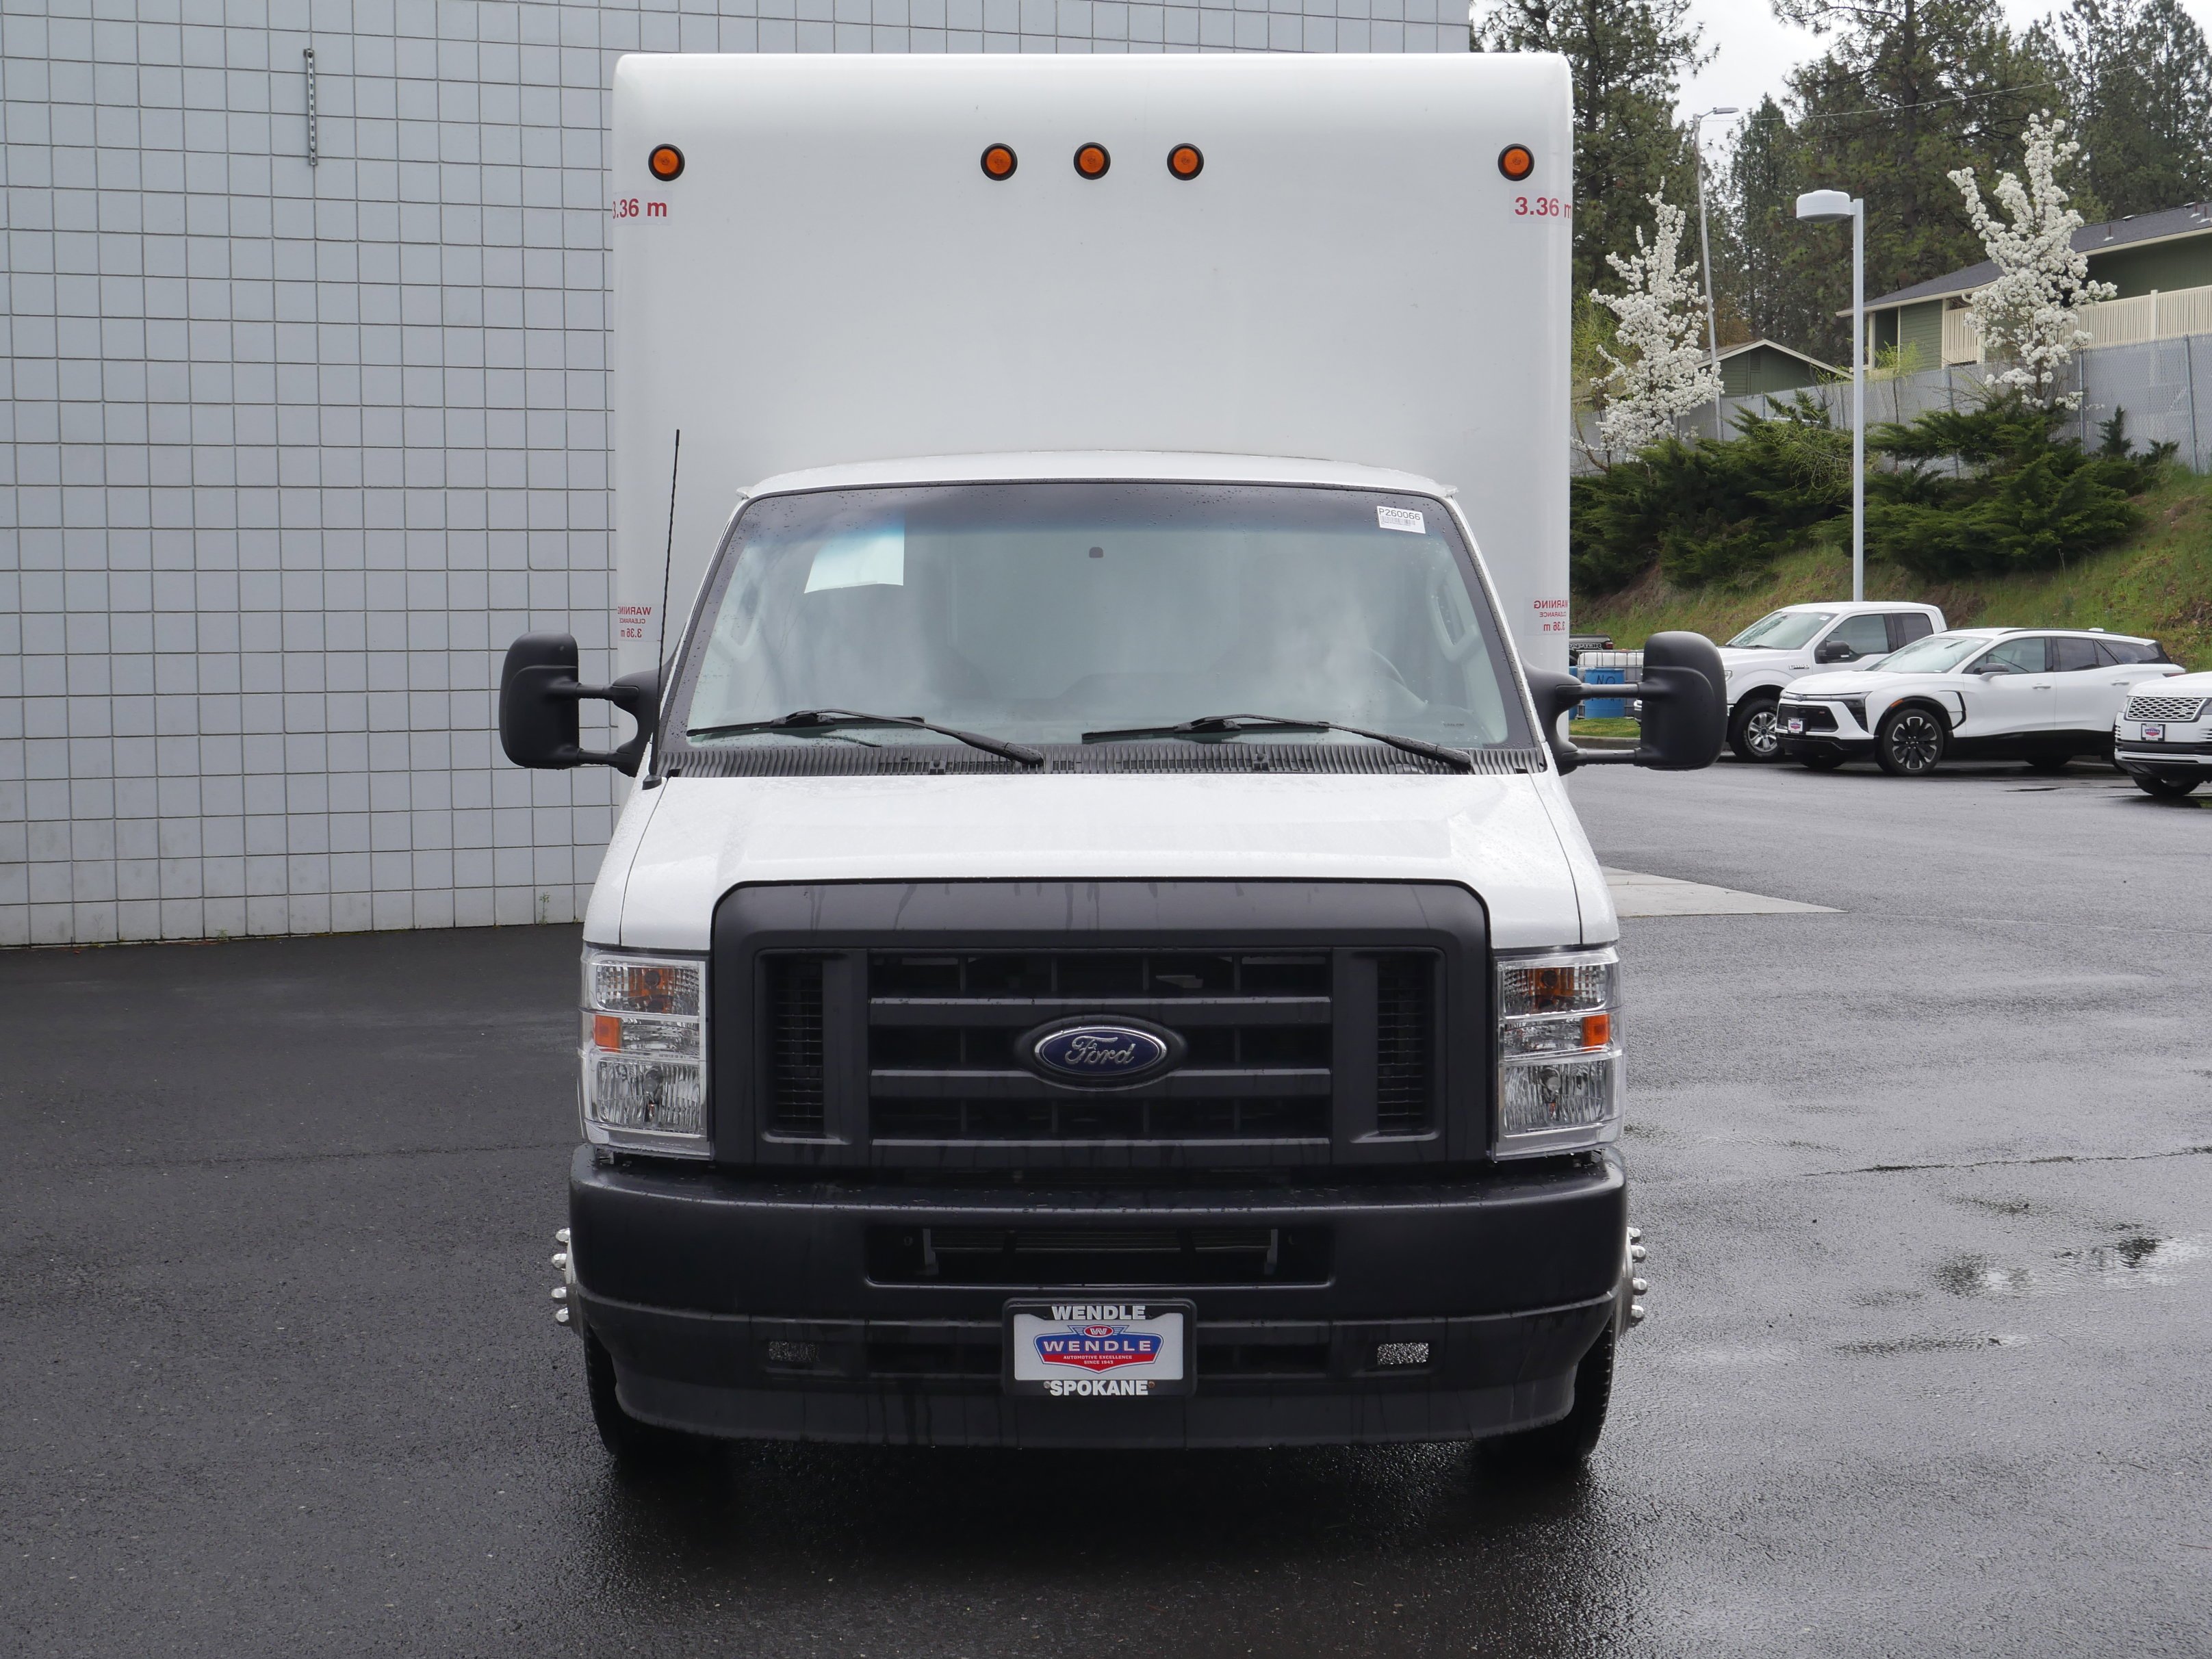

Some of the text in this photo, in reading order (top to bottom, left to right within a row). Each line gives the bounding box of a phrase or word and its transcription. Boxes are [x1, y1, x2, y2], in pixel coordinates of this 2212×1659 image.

[647, 202, 667, 217] m
[1515, 196, 1560, 216] 3.36
[1378, 508, 1421, 520] P260066
[1064, 1035, 1137, 1065] Ford
[1051, 1305, 1146, 1320] WENDLE
[1043, 1341, 1151, 1352] WENDLE
[1050, 1380, 1148, 1396] SPOKANE
